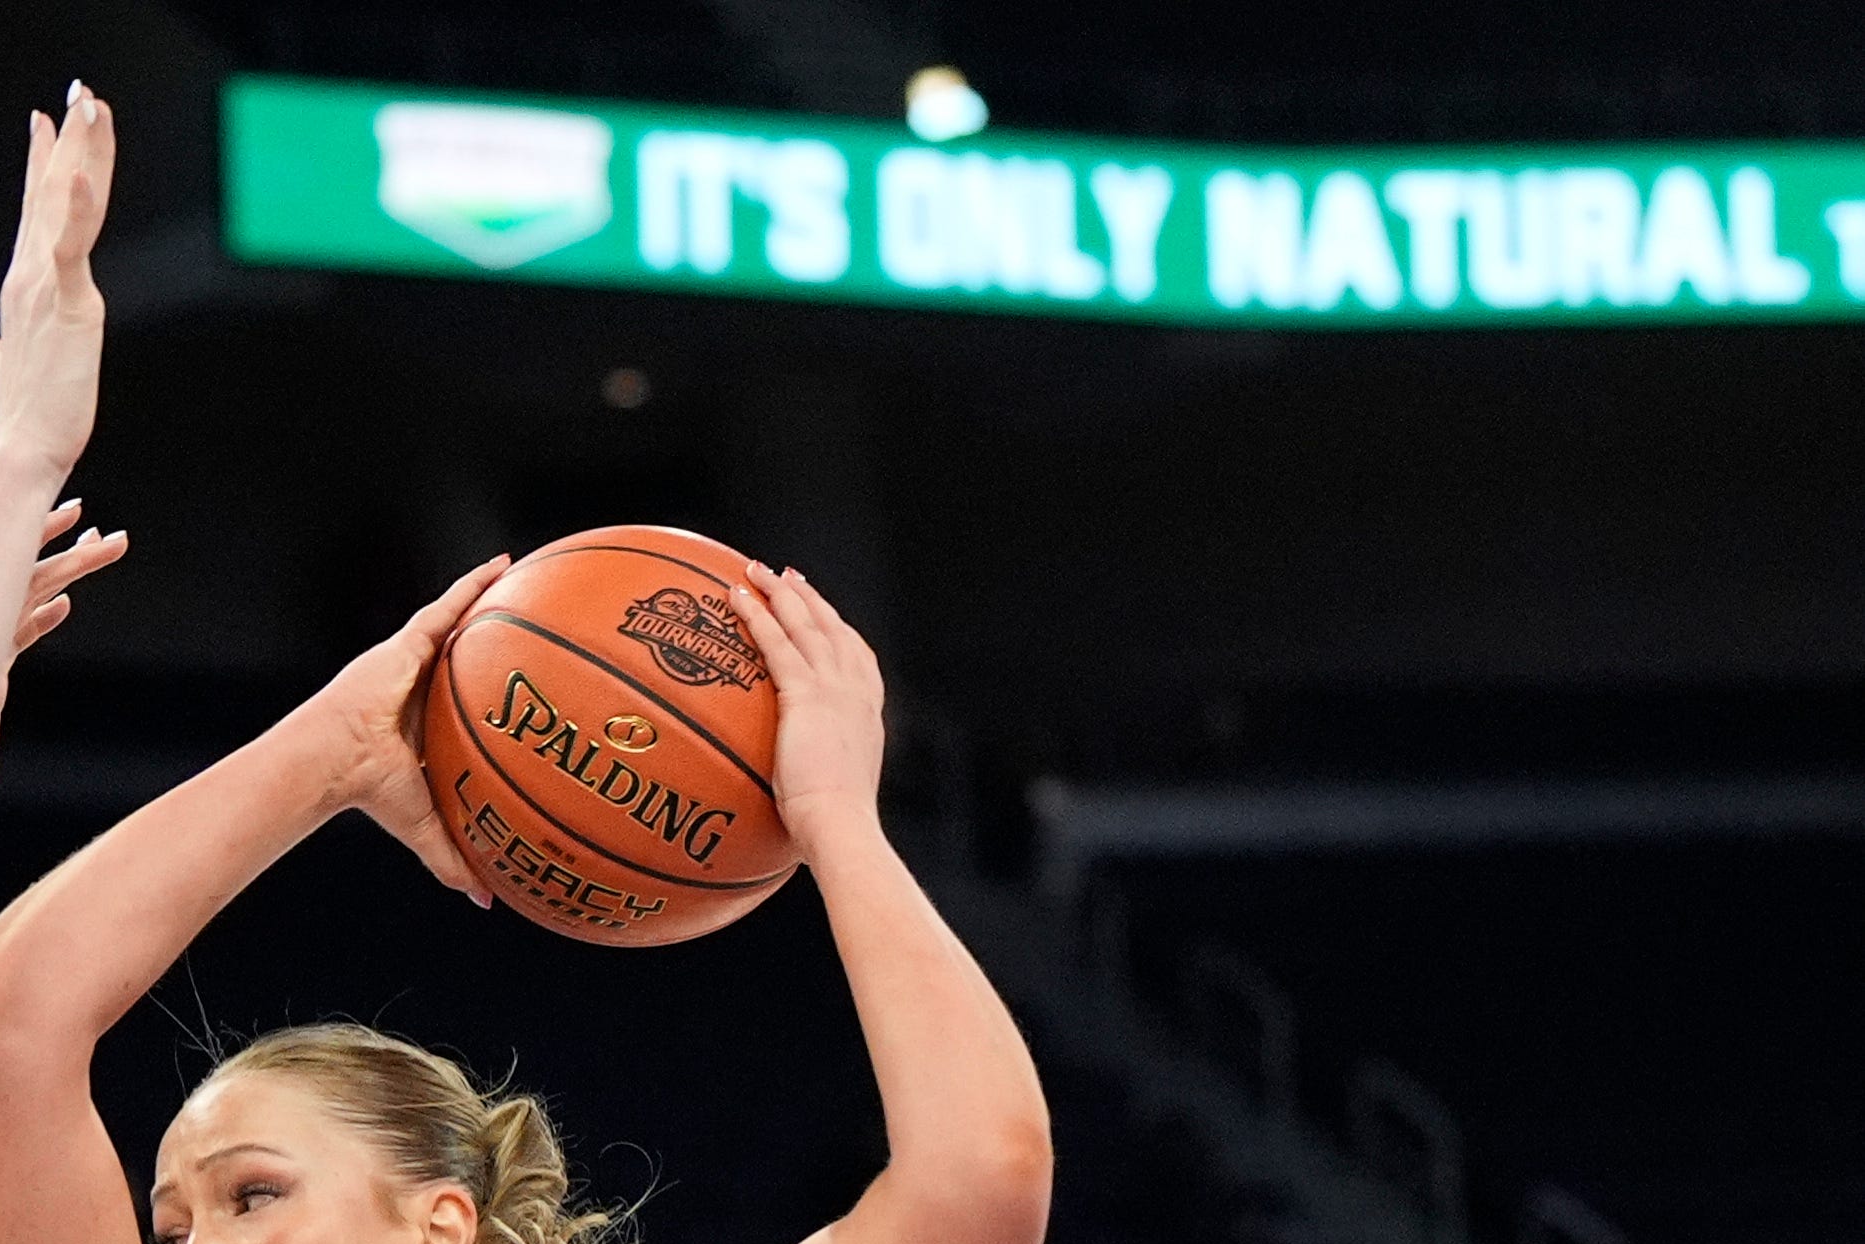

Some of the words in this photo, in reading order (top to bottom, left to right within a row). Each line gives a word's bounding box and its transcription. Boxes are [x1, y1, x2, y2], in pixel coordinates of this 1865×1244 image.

[636, 128, 850, 283] IT'S
[876, 146, 1173, 303] ONLY
[1204, 166, 1811, 310] NATURAL
[625, 606, 763, 688] TOURNAMENT
[702, 593, 735, 621] ally
[455, 768, 667, 919] LEGACY
[482, 669, 737, 867] SPALDING
